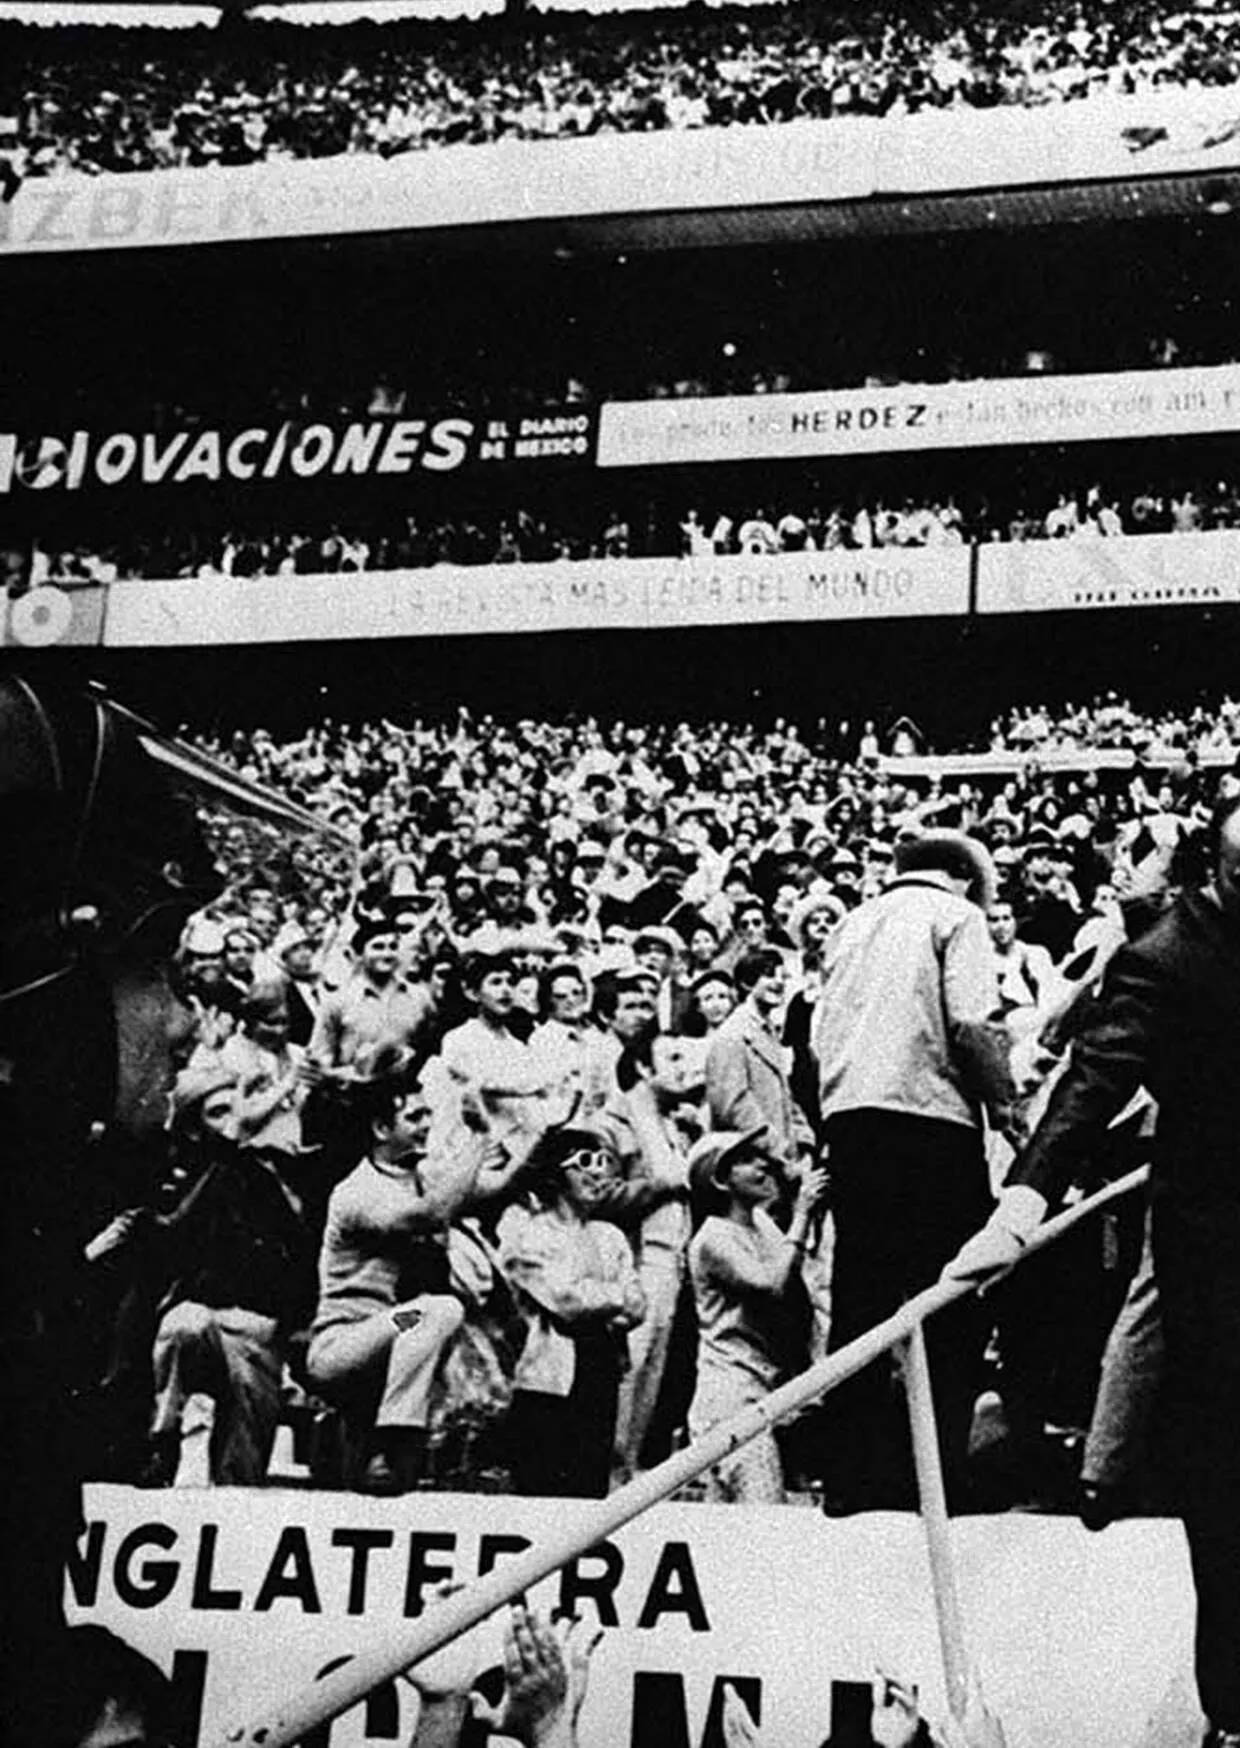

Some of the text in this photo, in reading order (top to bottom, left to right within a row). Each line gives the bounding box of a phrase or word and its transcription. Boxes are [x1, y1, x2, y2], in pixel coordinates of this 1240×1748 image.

[487, 421, 510, 438] EL
[520, 414, 589, 436] DIARIO
[791, 403, 928, 433] HERDEZ
[95, 418, 474, 484] OVACIONES
[479, 435, 589, 460] DE MEXICO
[805, 567, 914, 600] MUNDO
[64, 1520, 711, 1632] NGLATERA
